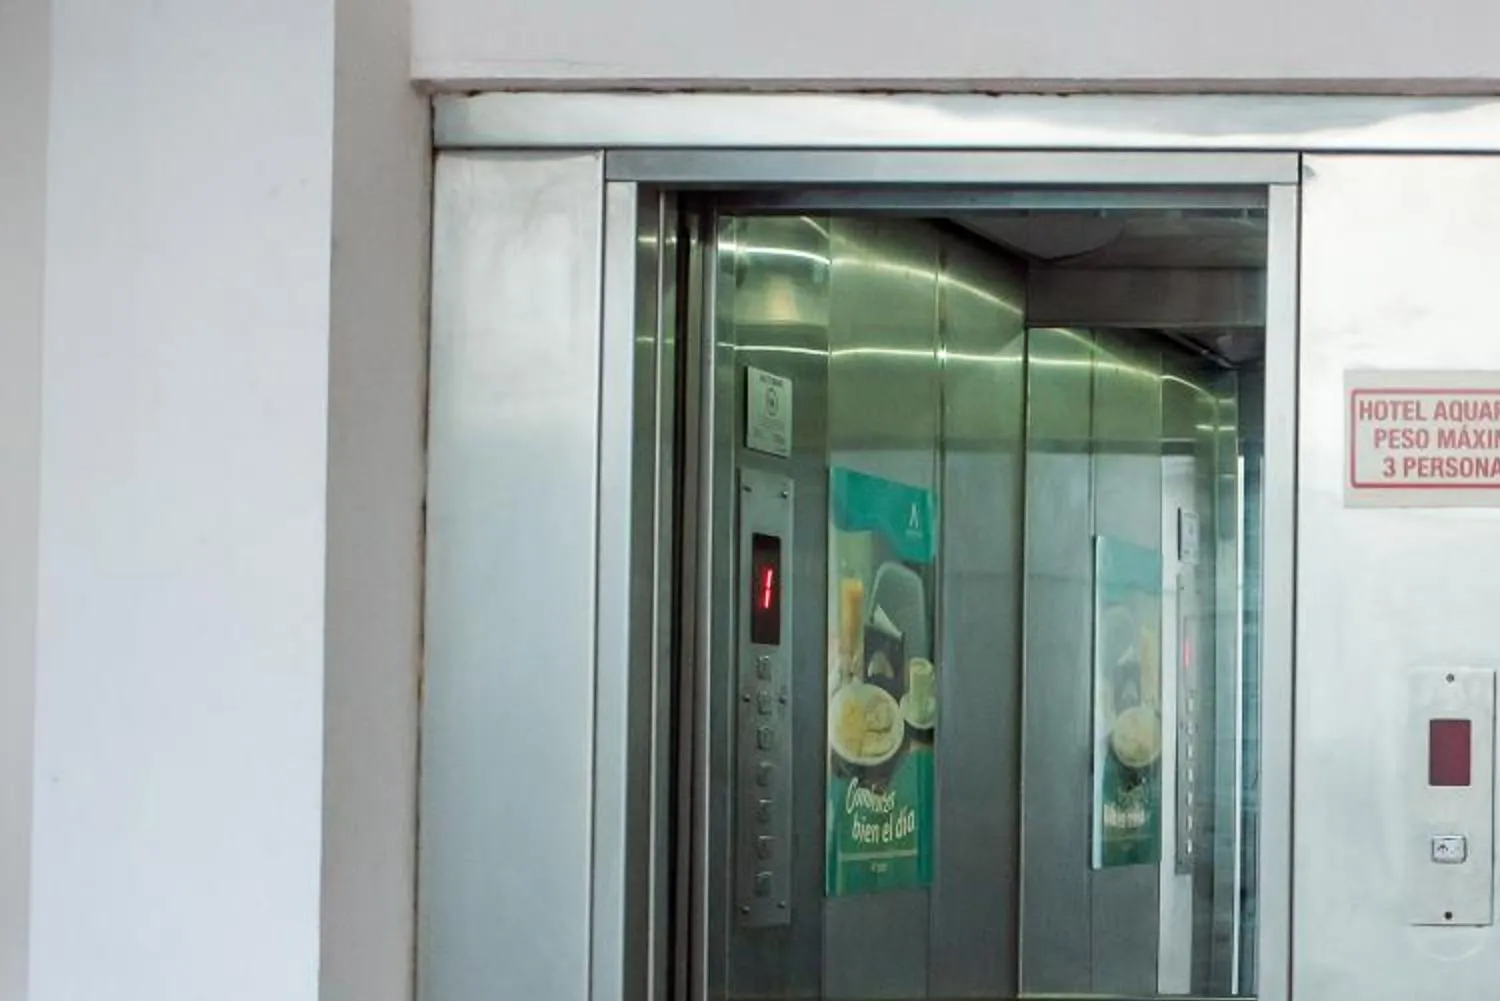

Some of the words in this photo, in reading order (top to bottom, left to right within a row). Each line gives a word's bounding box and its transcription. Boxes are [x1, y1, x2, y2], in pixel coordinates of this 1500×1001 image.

[1359, 400, 1427, 421] HOTEL
[1374, 428, 1429, 449] PESO
[1383, 457, 1396, 477] 3
[764, 567, 773, 609] 1
[852, 811, 880, 844] bien
[882, 813, 893, 843] el
